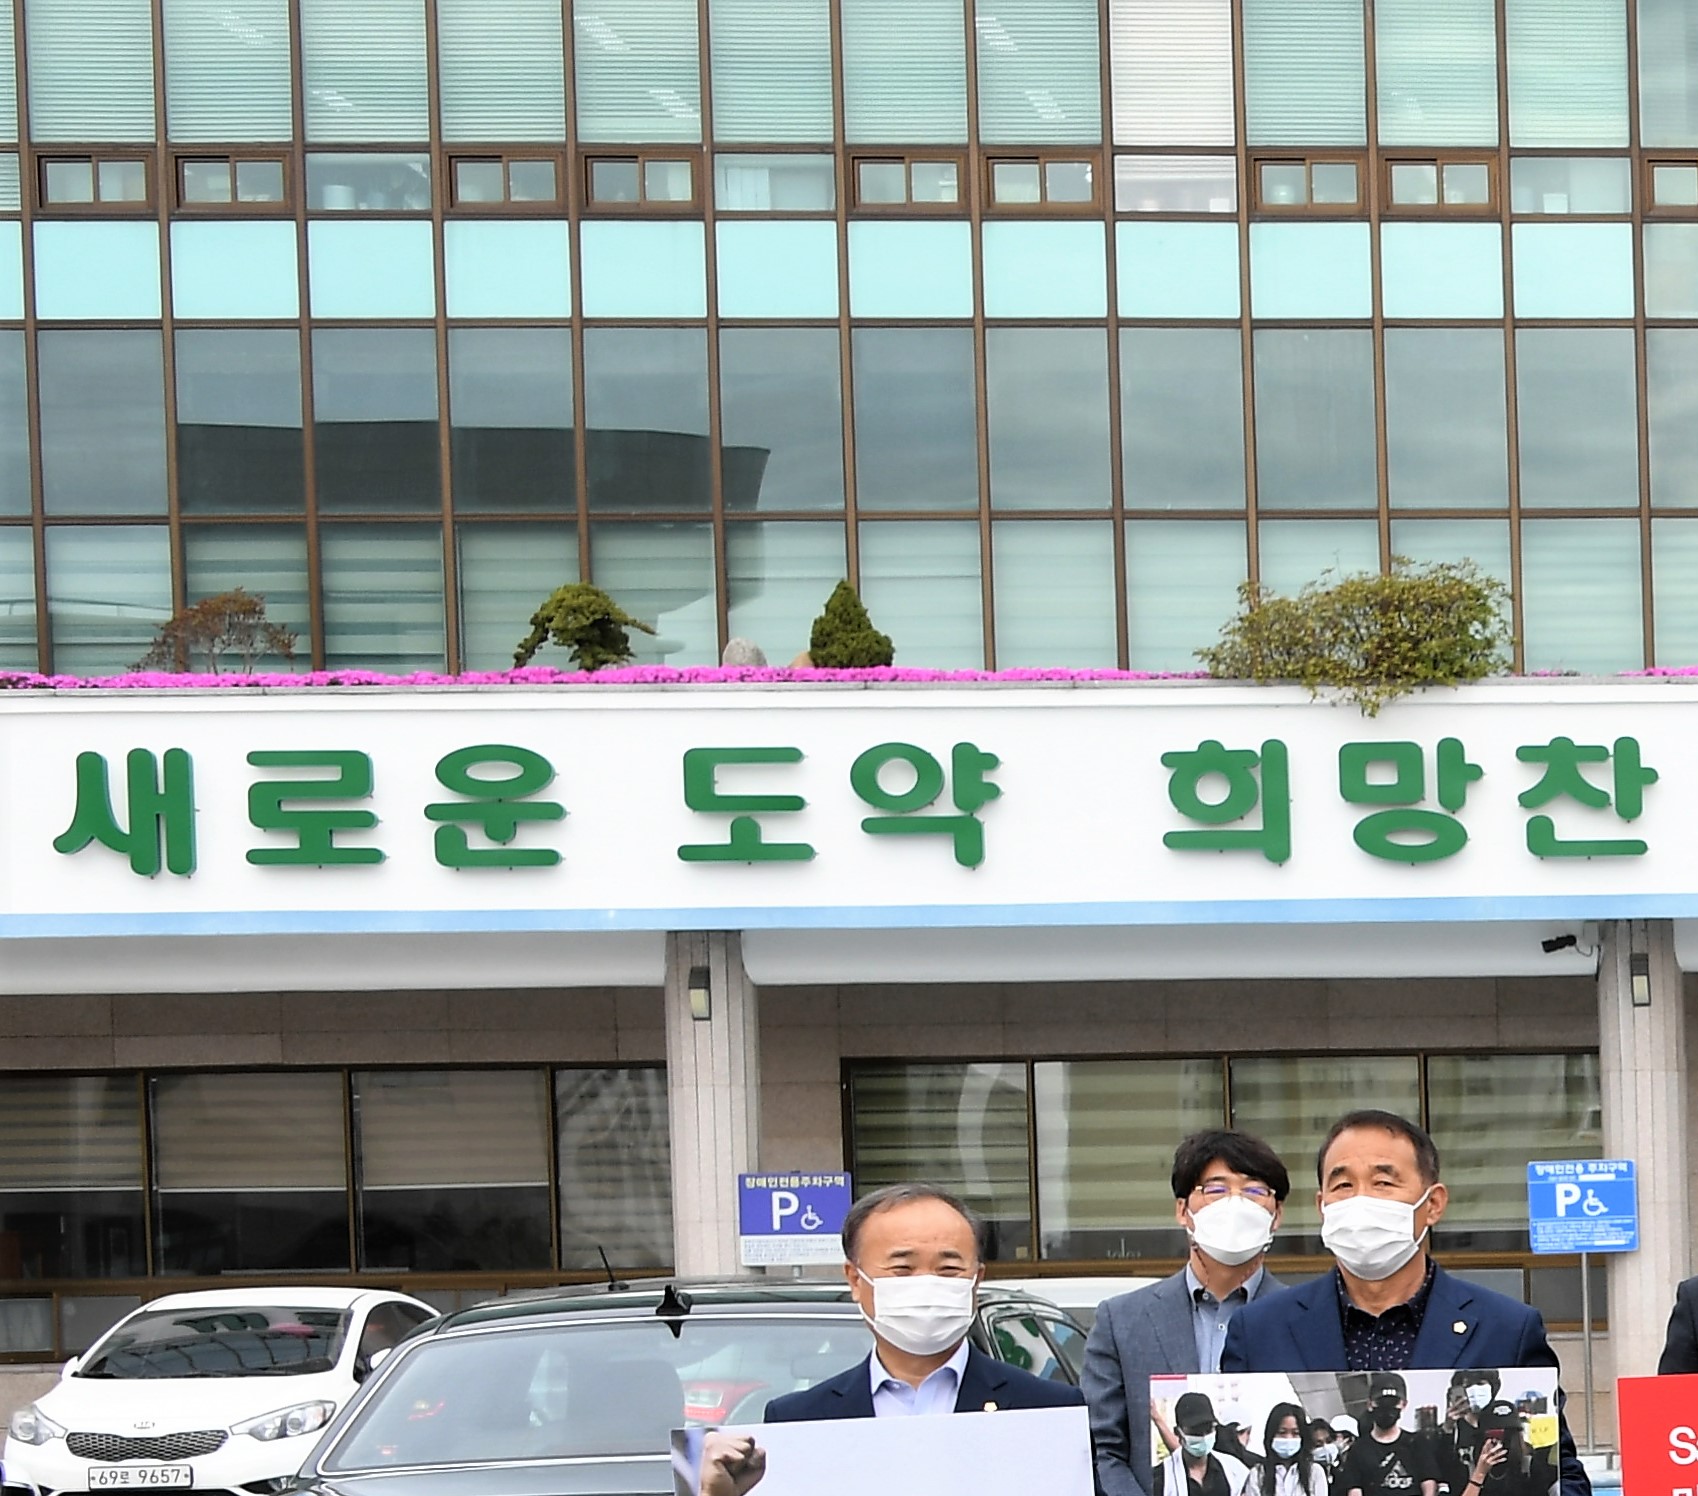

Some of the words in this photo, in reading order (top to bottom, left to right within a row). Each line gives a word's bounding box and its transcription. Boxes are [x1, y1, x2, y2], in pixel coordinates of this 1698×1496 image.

[56, 745, 563, 875] 새로운
[680, 743, 1000, 867] 도약
[1163, 738, 1657, 863] 희망찬
[771, 1191, 799, 1231] P
[1555, 1183, 1581, 1217] P
[98, 1470, 131, 1485] 69로
[138, 1469, 181, 1484] 9657
